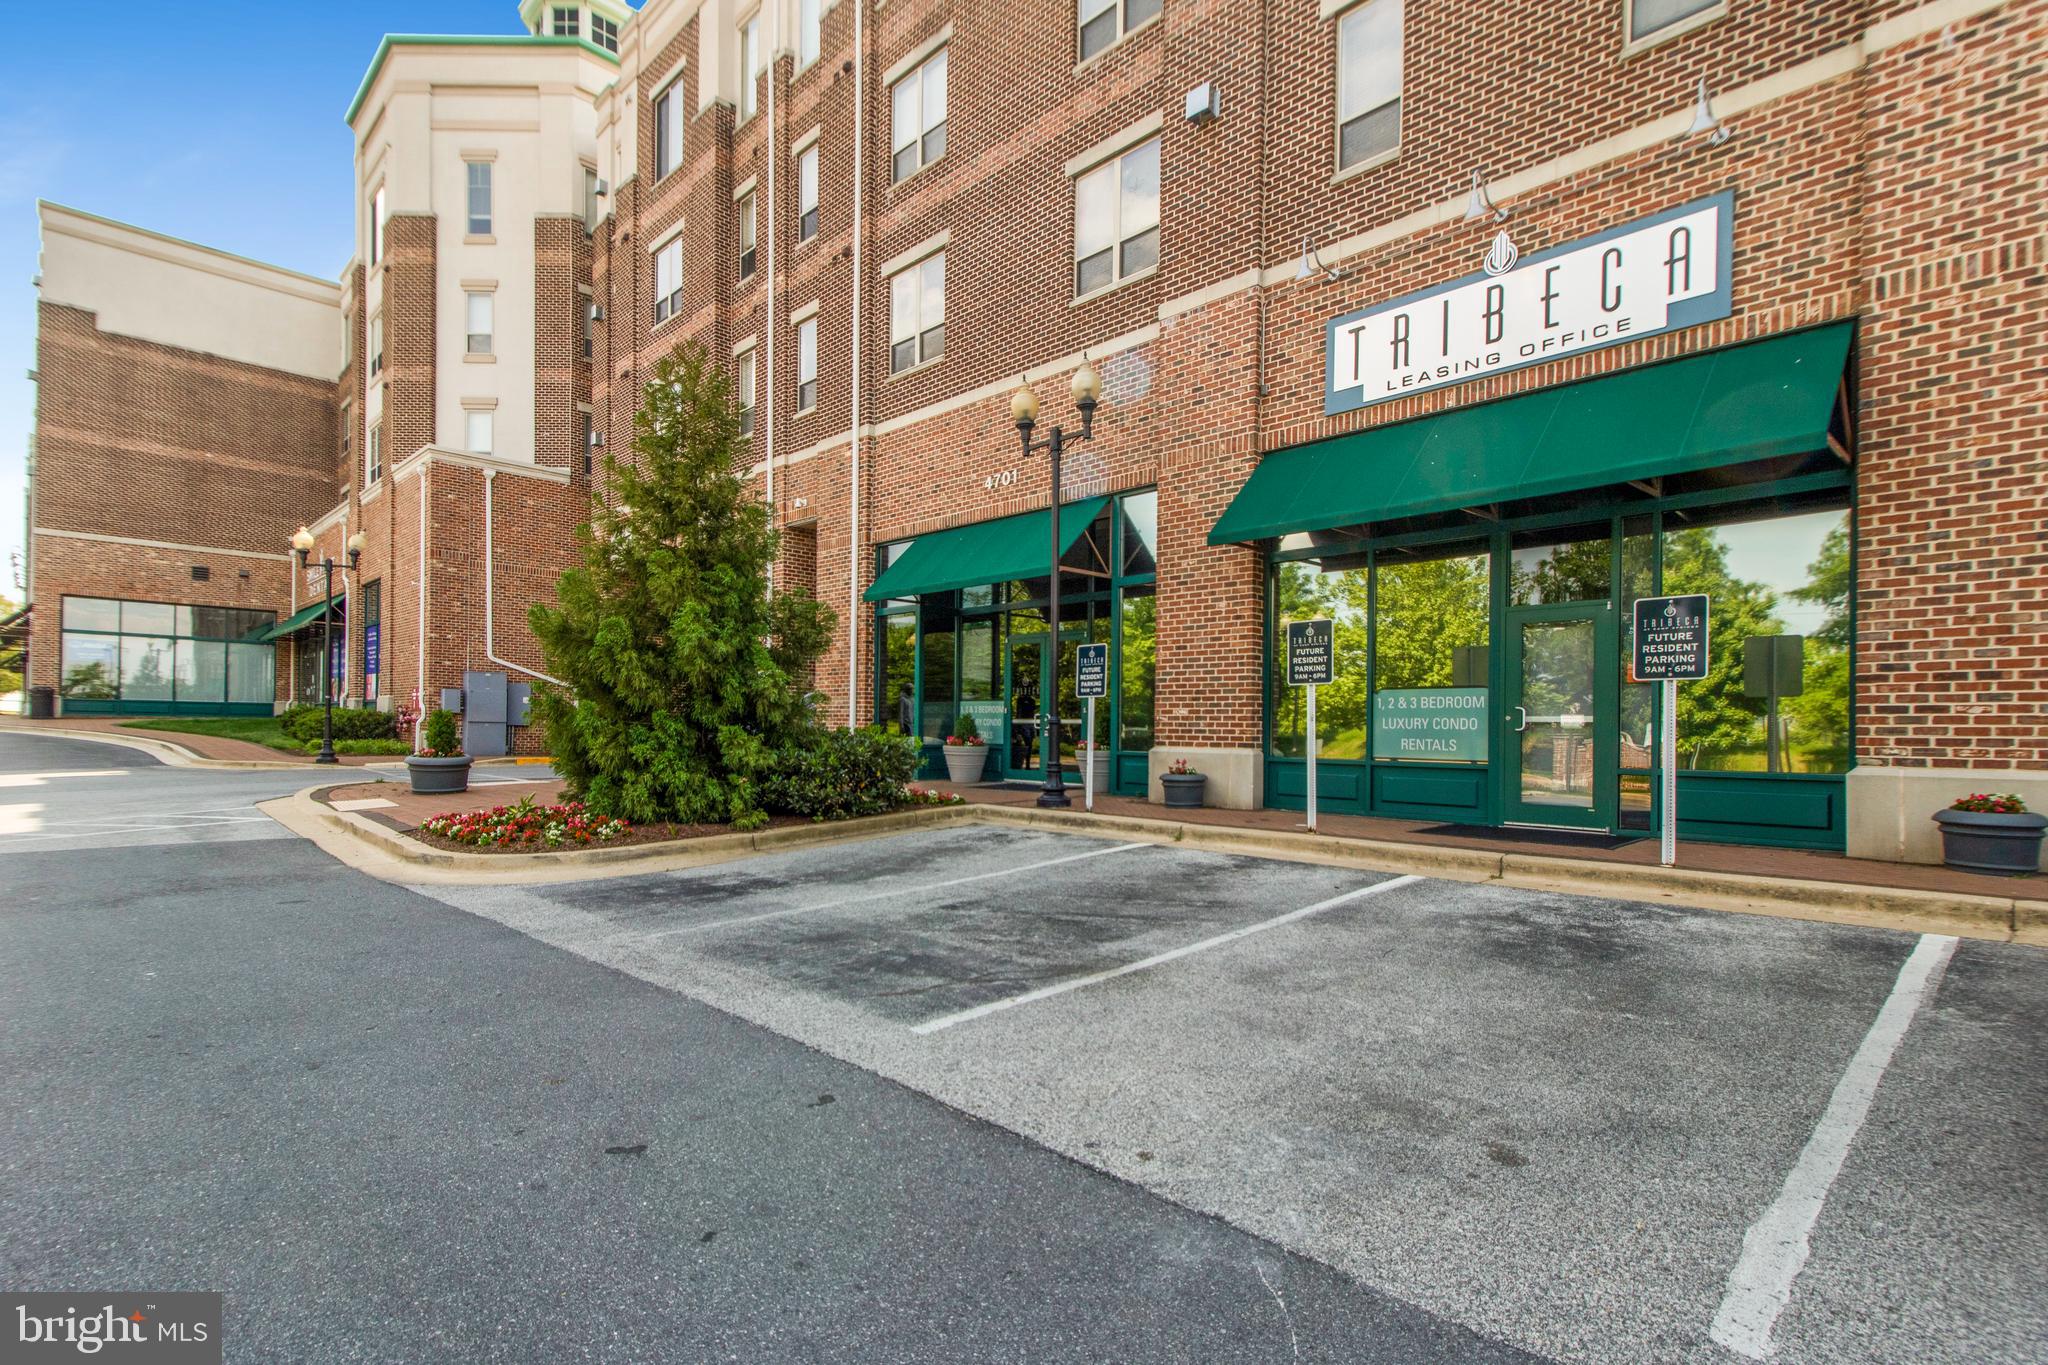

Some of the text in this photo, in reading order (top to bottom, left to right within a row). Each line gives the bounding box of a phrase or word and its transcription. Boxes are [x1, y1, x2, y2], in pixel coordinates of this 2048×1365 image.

[1348, 226, 1691, 381] TRIBECA
[1387, 317, 1632, 391] LEASING OFFICE
[984, 469, 1018, 490] 4701
[1643, 616, 1700, 629] TRIBECA
[1647, 632, 1694, 642] FUTURE
[1296, 647, 1325, 656] FUTURE
[1642, 643, 1699, 654] RESIDENT
[1292, 655, 1328, 665] RESIDENT
[1644, 654, 1696, 664] PARKING
[1294, 664, 1326, 673] PARKING
[1644, 665, 1666, 673] 9AM
[1080, 673, 1103, 681] RESIDENT
[1377, 695, 1485, 711] 1, 2 & 3 BEDROOM
[1382, 717, 1479, 730] LUXURY CONDO
[1401, 738, 1457, 752] RENTALS
